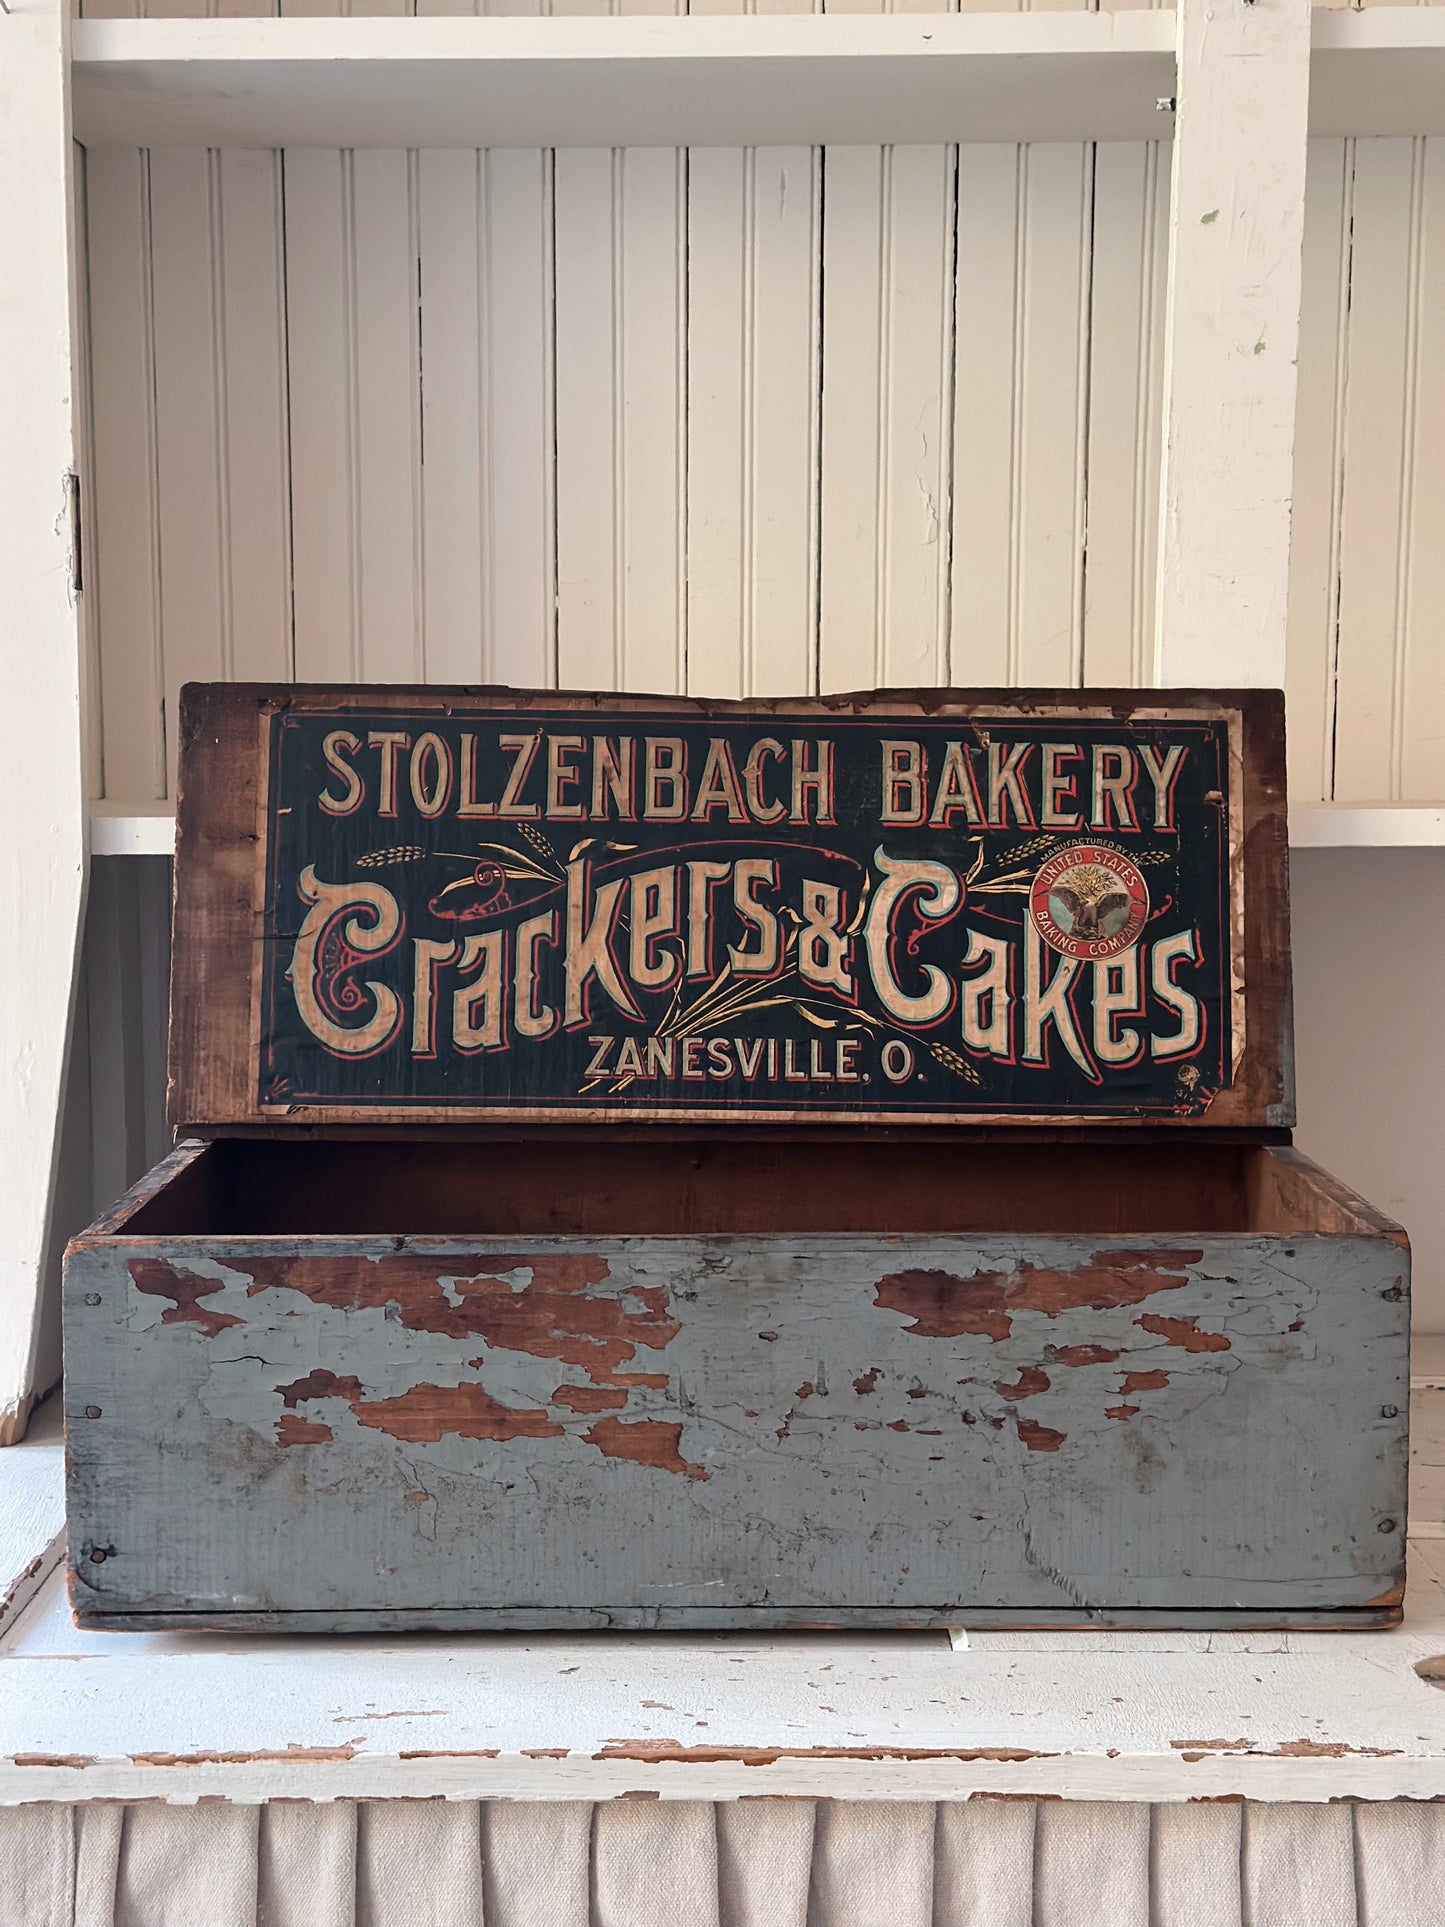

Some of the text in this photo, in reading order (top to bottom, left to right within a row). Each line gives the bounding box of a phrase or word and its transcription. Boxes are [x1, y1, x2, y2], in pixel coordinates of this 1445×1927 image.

[319, 729, 1190, 833] STOLZENBACH BAKERY
[1040, 837, 1143, 868] MANUFACTURED BY THE
[1040, 851, 1139, 887] UNITED STATES
[1036, 910, 1143, 956] BAKING COMPANY
[285, 843, 1210, 1086] Crackers & Cakes
[583, 1035, 928, 1085] ZANESVILLE, O.
